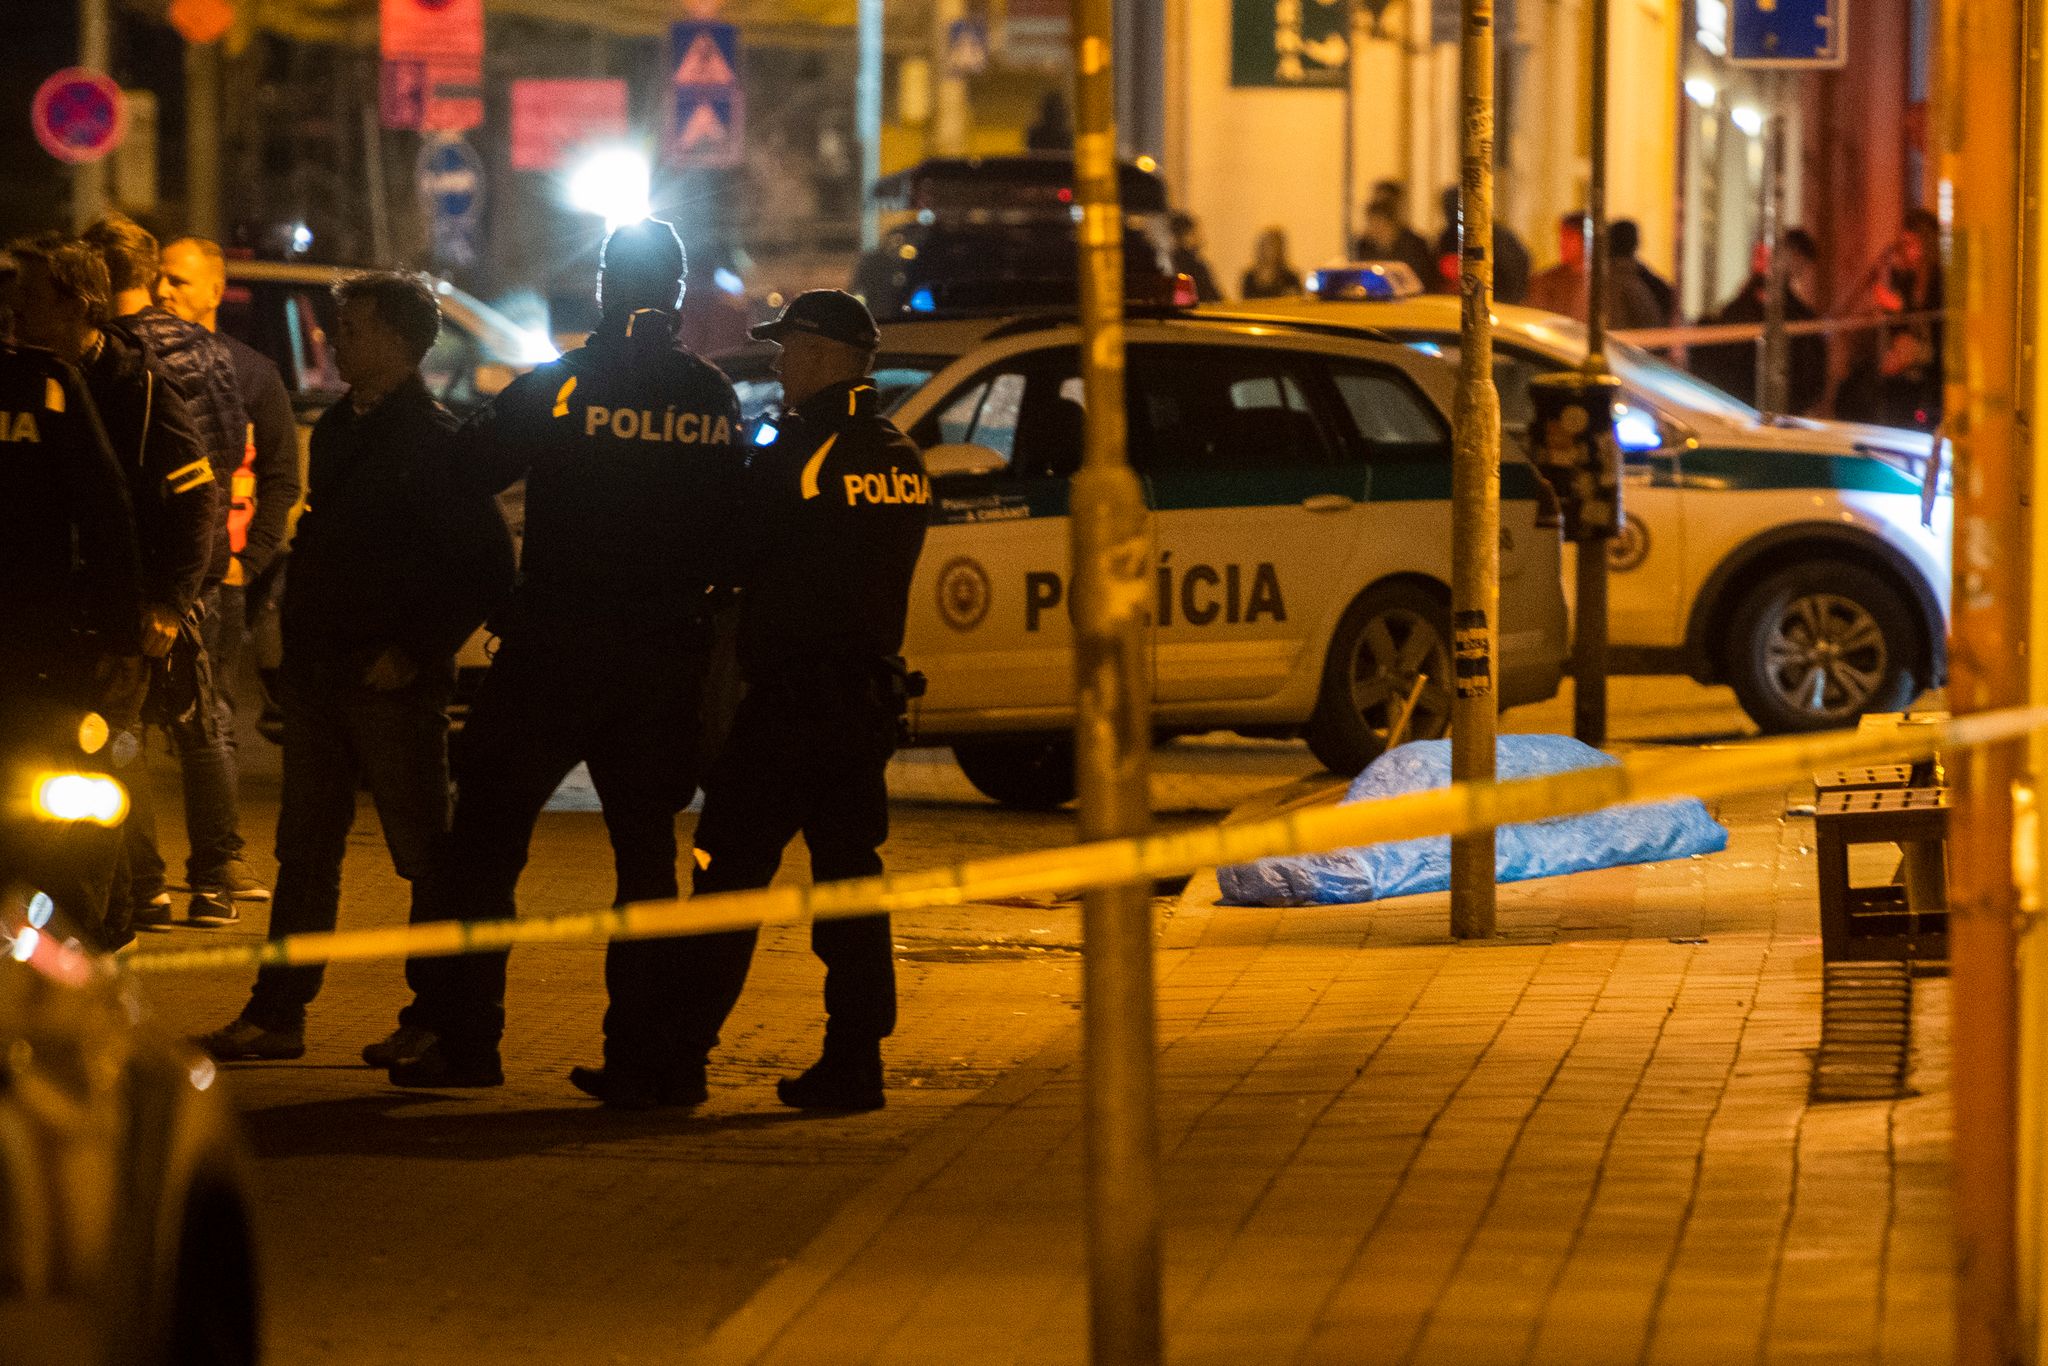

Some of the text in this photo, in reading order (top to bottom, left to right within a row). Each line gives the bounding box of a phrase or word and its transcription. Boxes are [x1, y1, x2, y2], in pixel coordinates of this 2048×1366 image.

[585, 405, 730, 445] POLÍCIA
[843, 466, 932, 506] POLÍCIA
[1025, 551, 1287, 632] PÍCIA
